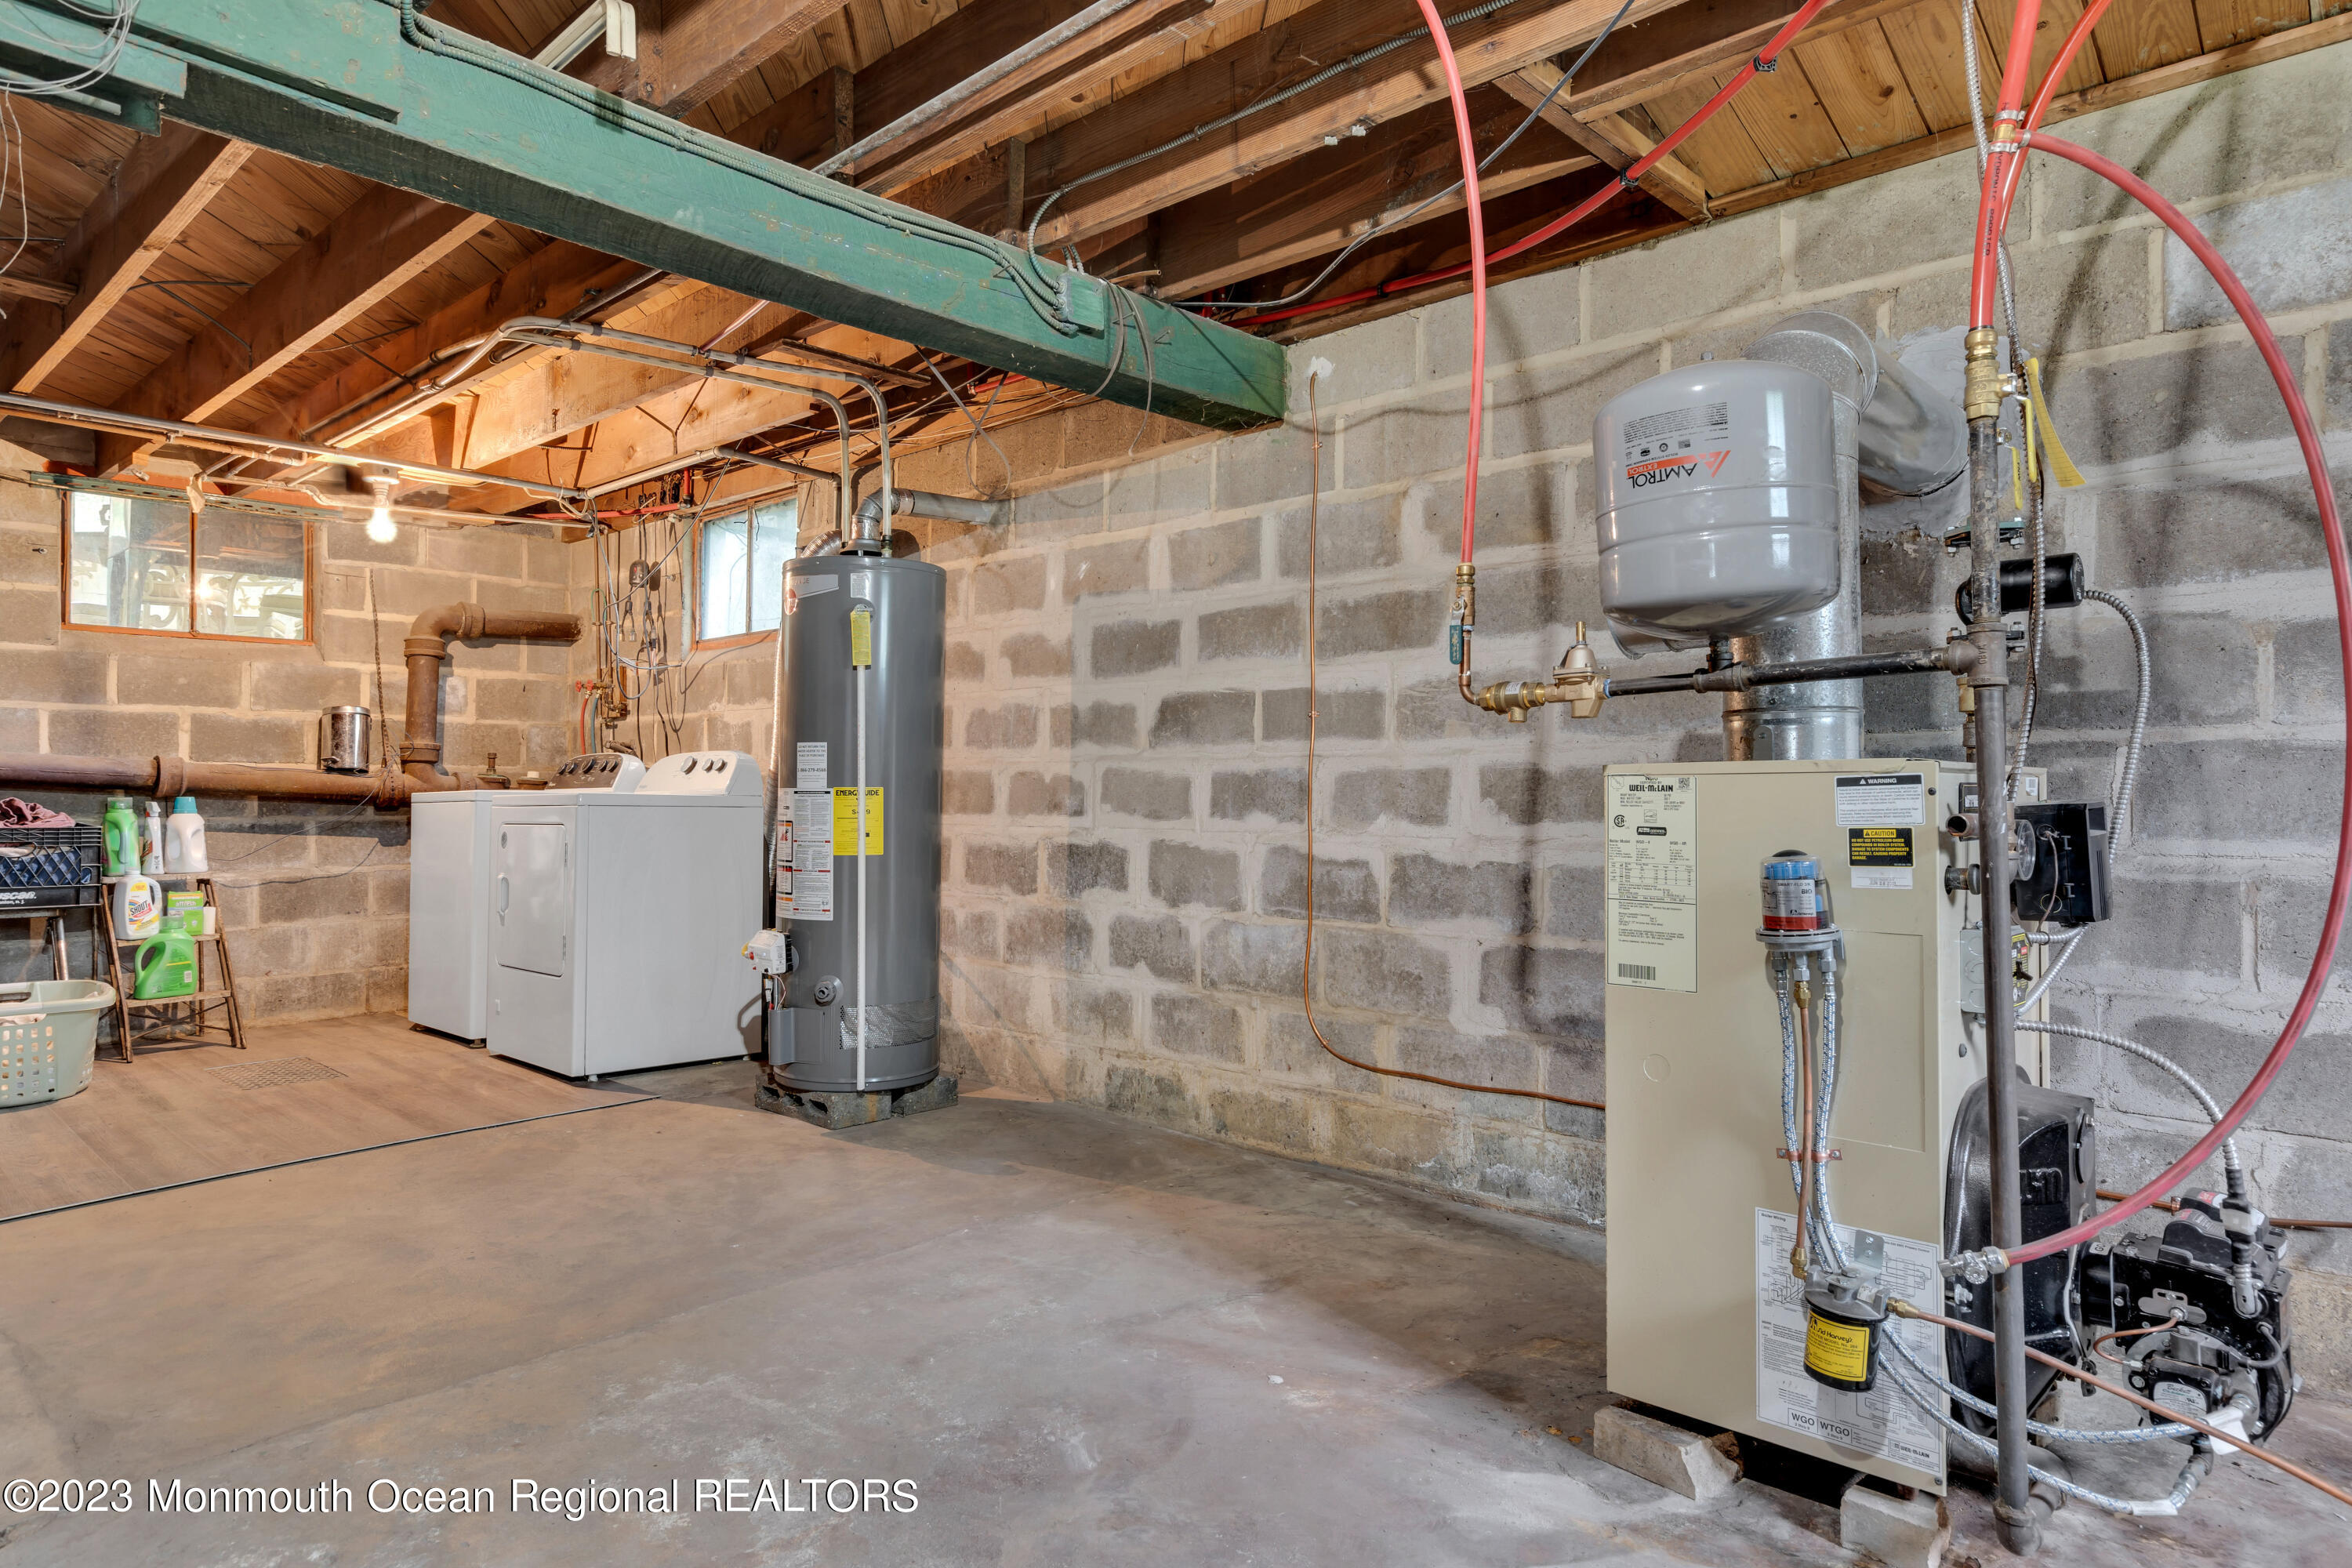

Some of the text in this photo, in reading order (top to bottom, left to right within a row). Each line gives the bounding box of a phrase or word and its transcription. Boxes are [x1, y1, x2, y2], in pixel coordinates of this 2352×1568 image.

[1628, 463, 1697, 488] AMTROL
[1629, 463, 1658, 474] EXTROL
[129, 899, 149, 916] SHOUT
[1827, 1330, 1853, 1343] Harvey's
[1791, 1412, 1815, 1426] WGO
[1820, 1421, 1850, 1436] WTGO
